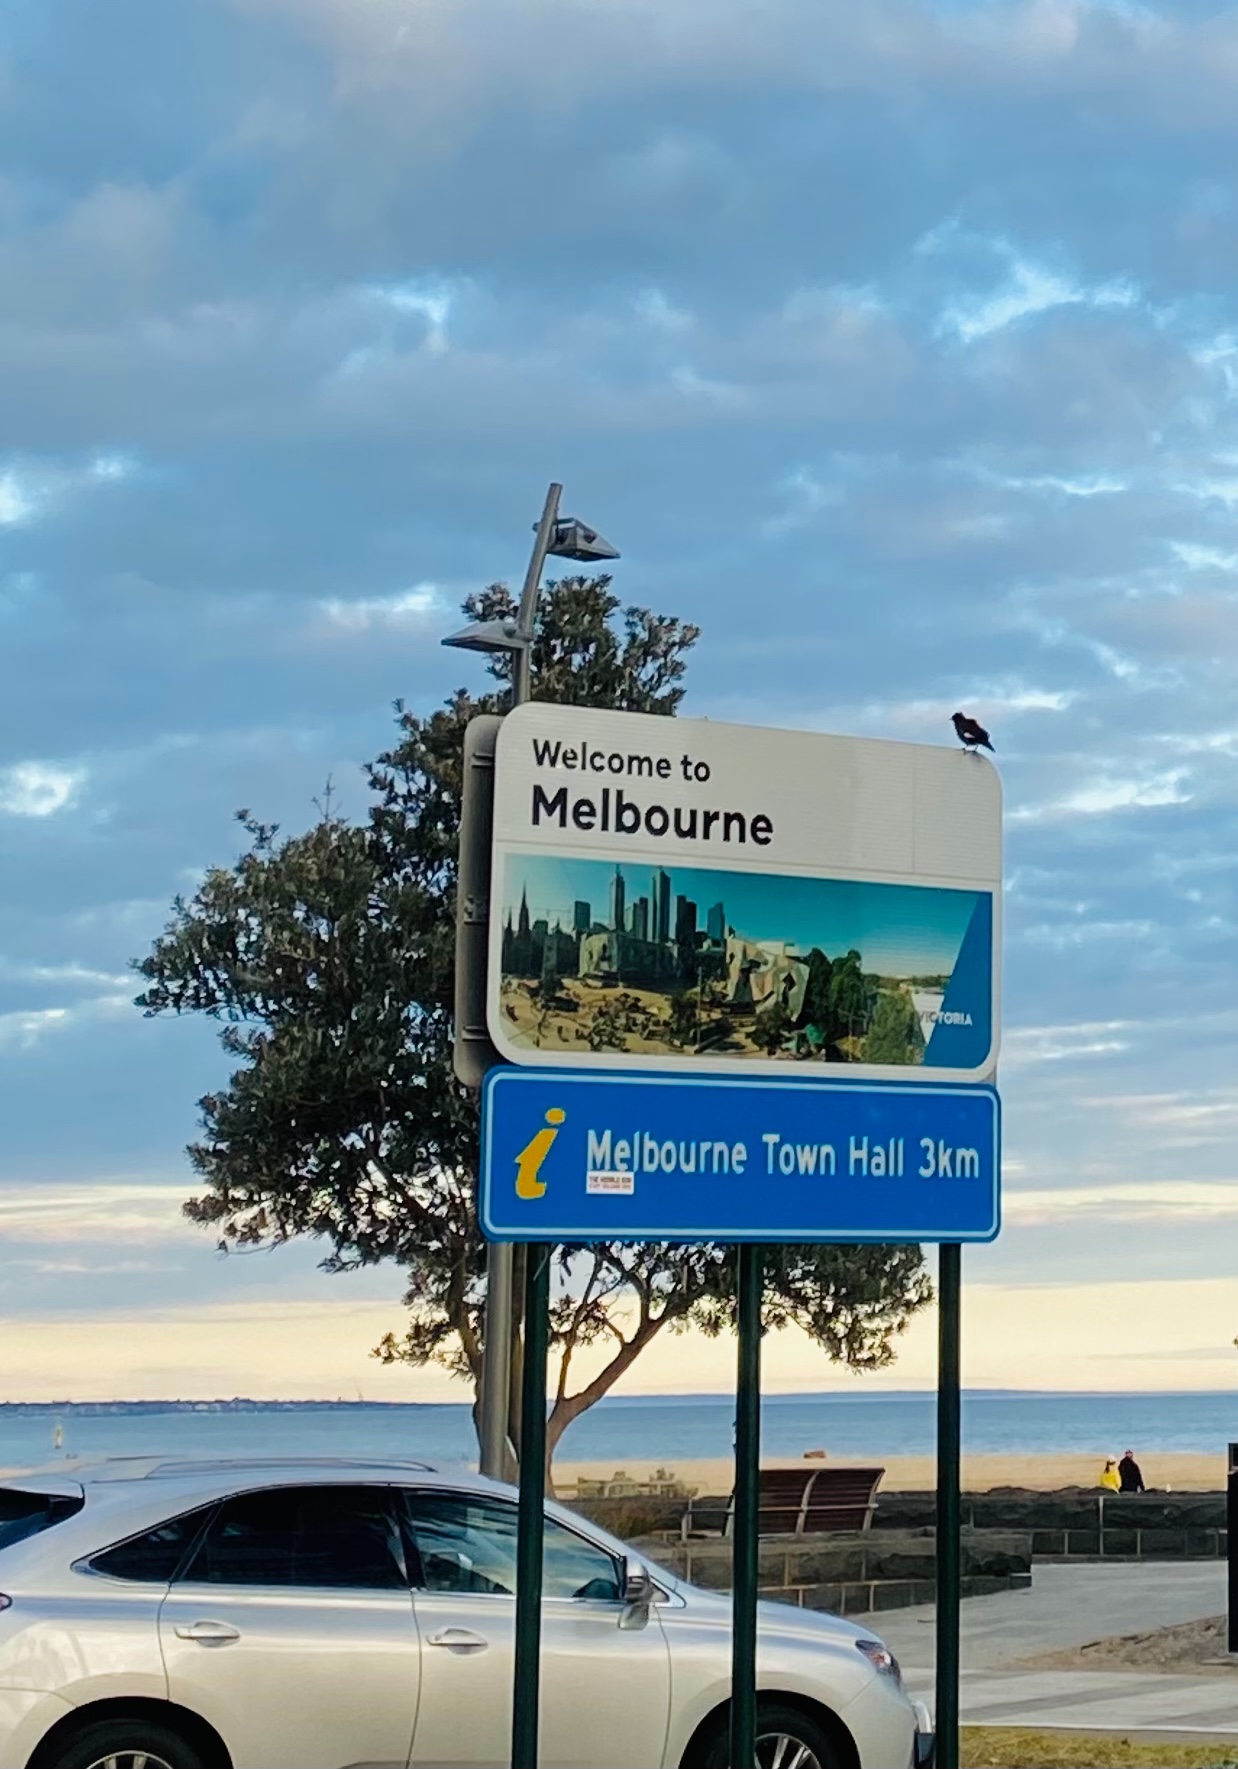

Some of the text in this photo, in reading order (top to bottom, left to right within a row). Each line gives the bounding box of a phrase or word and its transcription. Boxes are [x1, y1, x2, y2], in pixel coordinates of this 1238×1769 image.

[532, 738, 711, 782] Welcome to
[531, 784, 774, 845] Melbourne
[919, 1010, 973, 1026] VICTORIA
[586, 1128, 980, 1179] Melbourne Town Hall 3km
